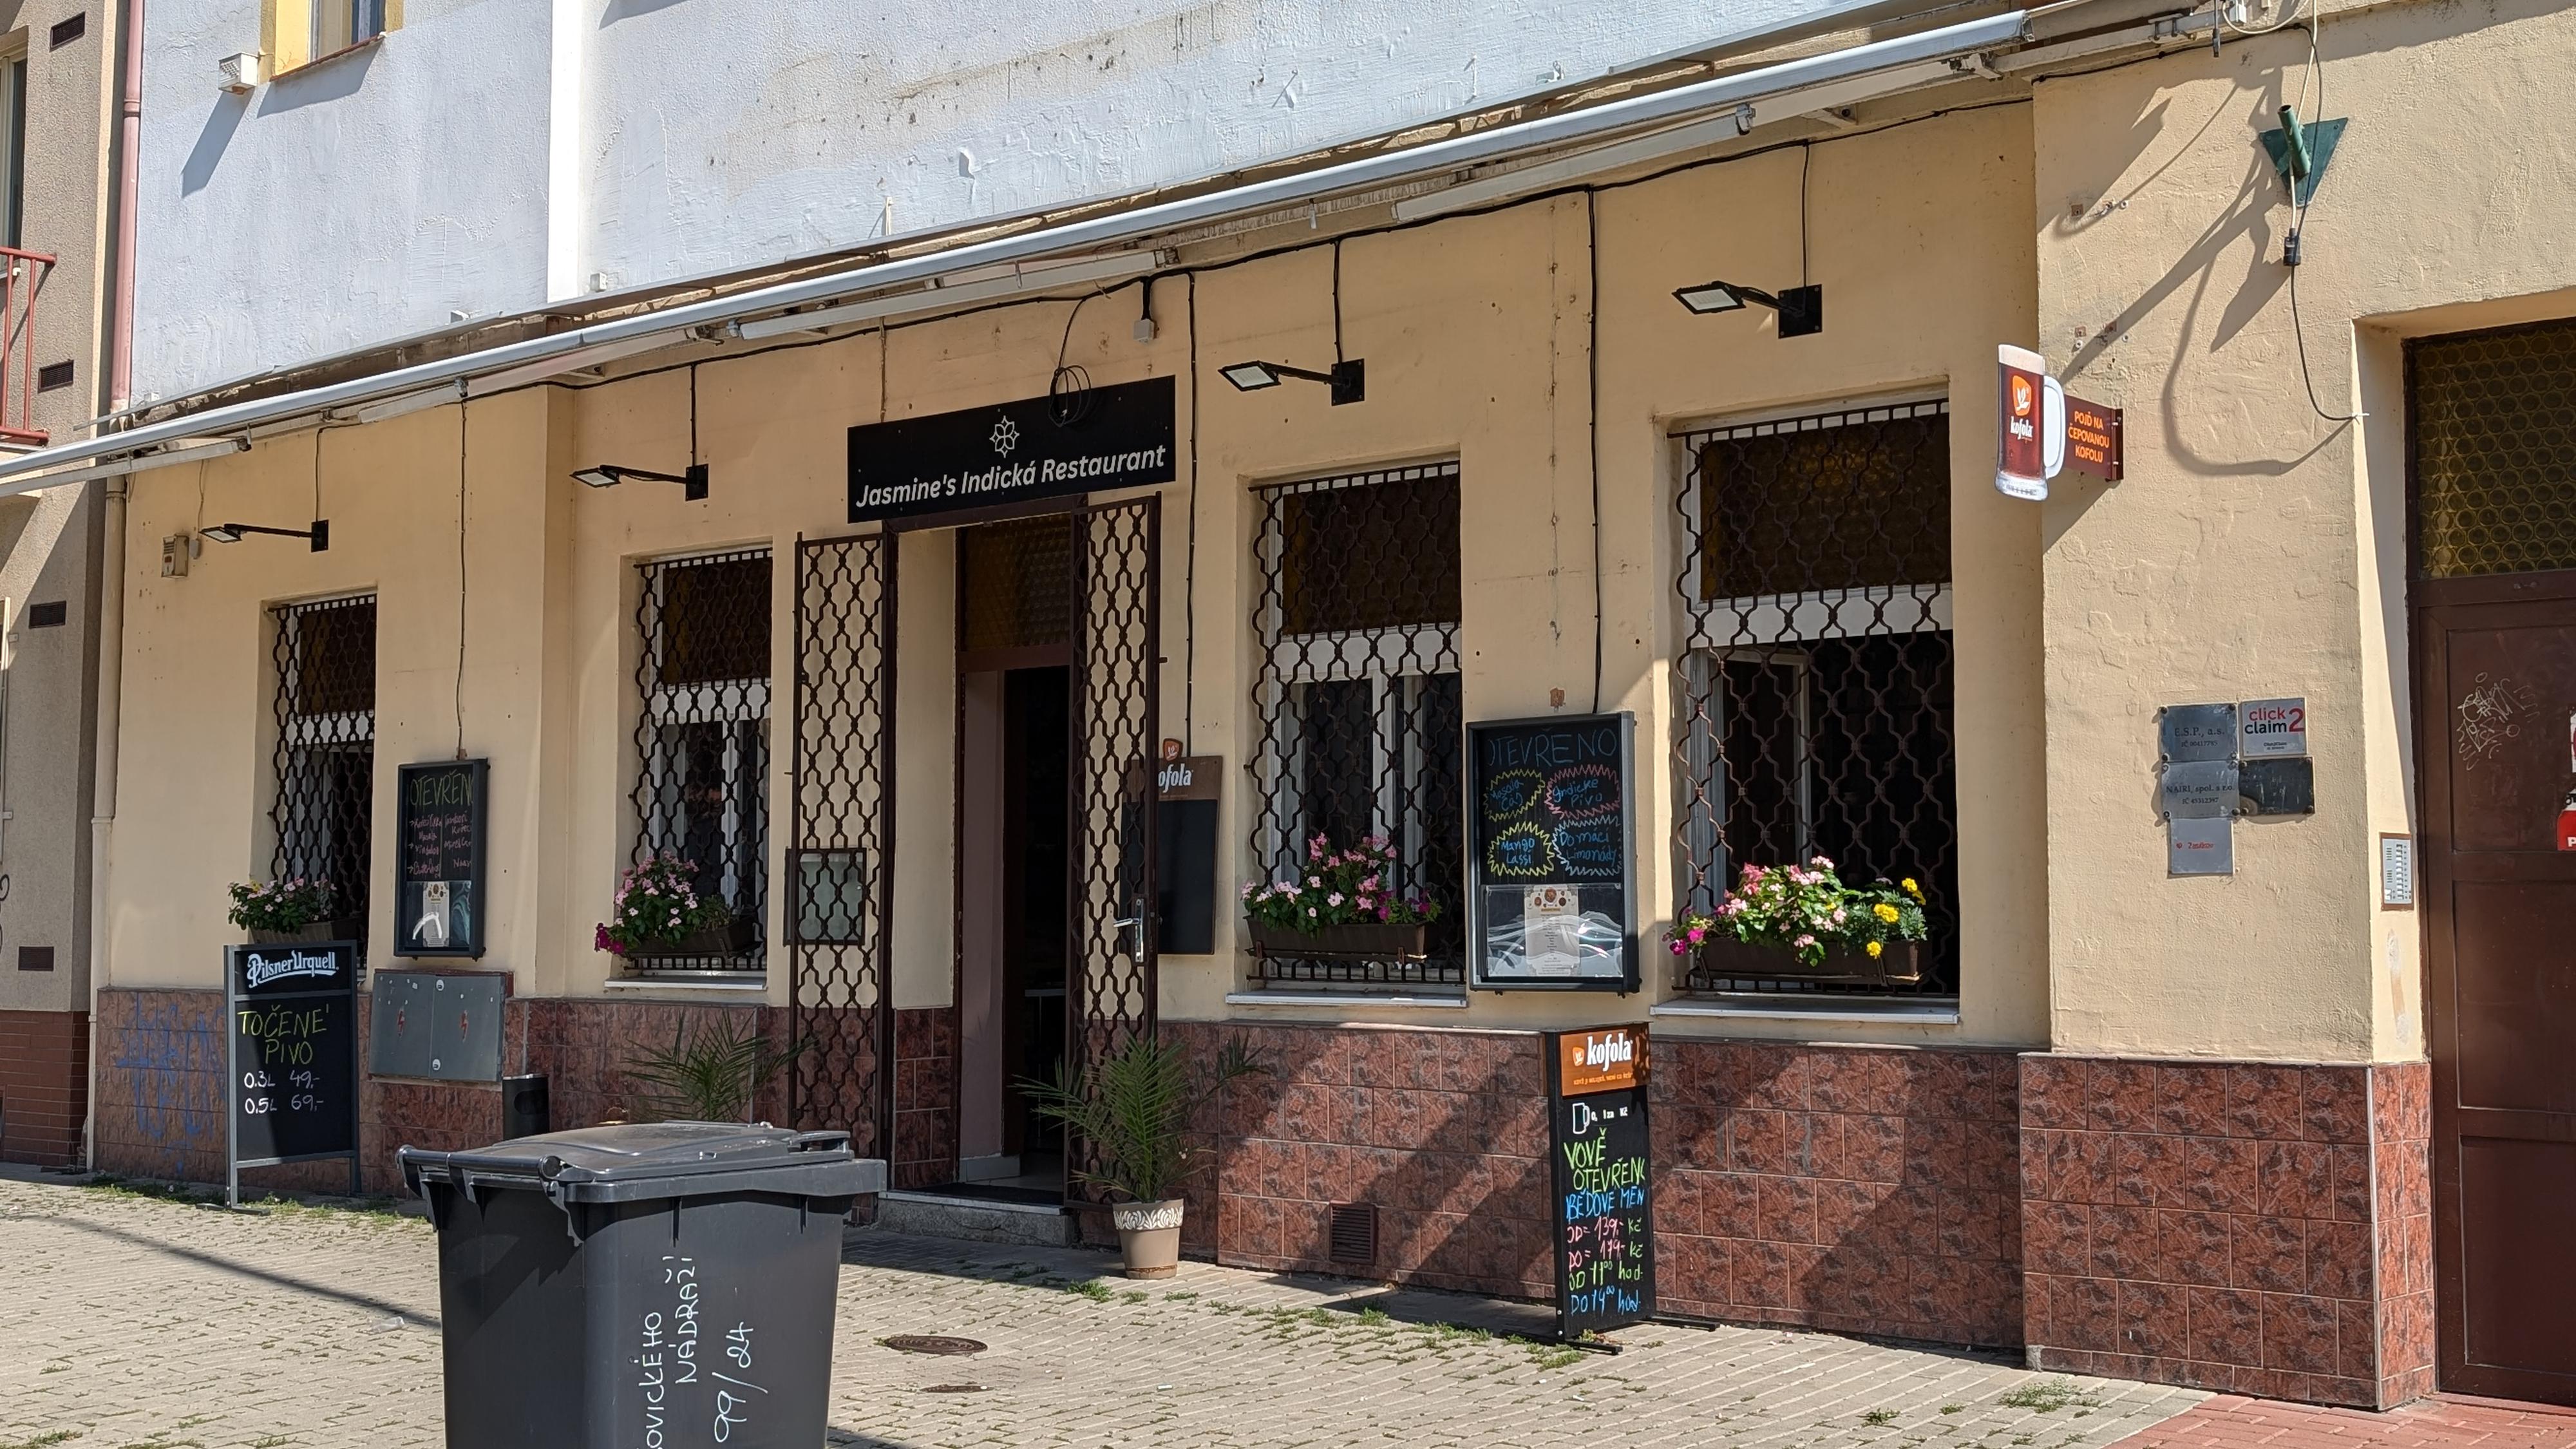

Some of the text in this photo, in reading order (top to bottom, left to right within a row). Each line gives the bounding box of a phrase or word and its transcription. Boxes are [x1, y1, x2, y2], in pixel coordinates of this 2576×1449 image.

[2010, 416, 2034, 439] kofola
[2074, 411, 2103, 430] POJĎ NA
[2068, 422, 2109, 449] ČEPOVANOU
[2075, 444, 2103, 463] KOFOLU
[856, 444, 1166, 507] Jasmine's Indická Restaurant
[2244, 708, 2304, 735] claim 2
[2249, 706, 2286, 721] click
[1159, 763, 1192, 793] ofola
[1501, 837, 1535, 852] Mango
[1507, 850, 1532, 866] Lassi
[247, 949, 336, 989] Pilsner Urquell
[236, 1004, 329, 1038] TOČENÉ
[265, 1038, 314, 1065] PIVO
[1586, 1032, 1632, 1072] kofola
[1627, 1217, 1642, 1236] Kč
[1629, 1240, 1643, 1258] Kč
[1569, 1271, 1586, 1291] OD
[1571, 1294, 1588, 1316] DO
[633, 1311, 665, 1449] OVICKÉHO
